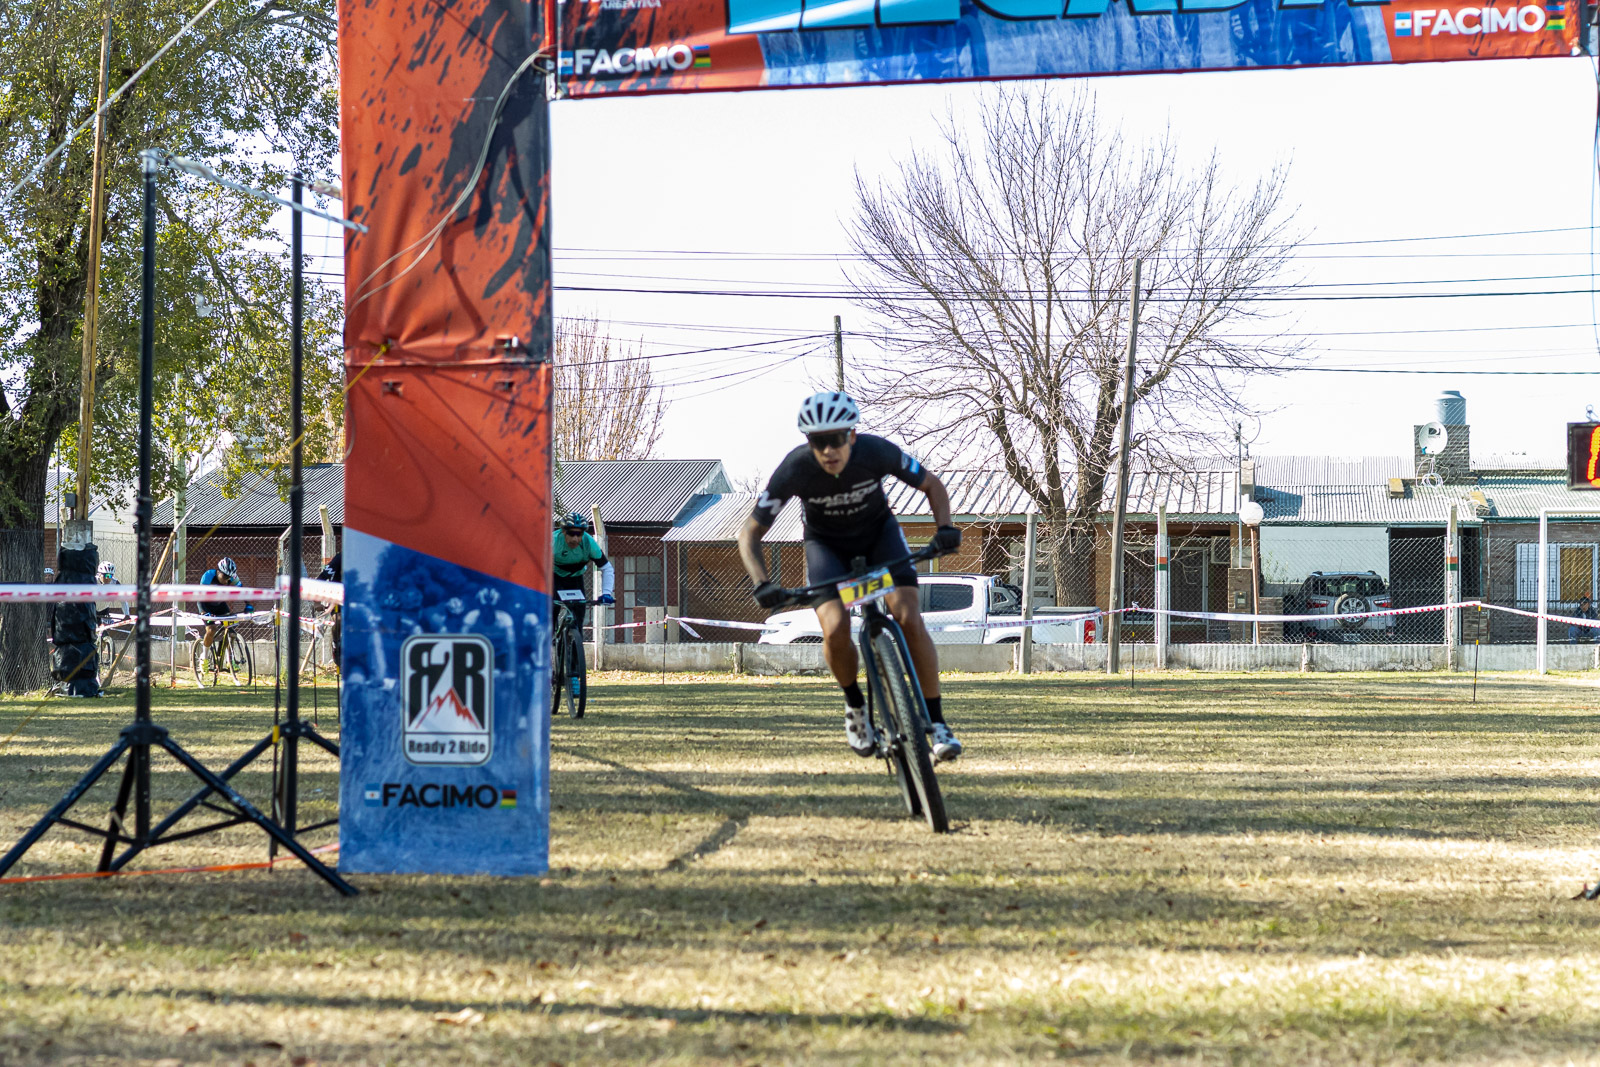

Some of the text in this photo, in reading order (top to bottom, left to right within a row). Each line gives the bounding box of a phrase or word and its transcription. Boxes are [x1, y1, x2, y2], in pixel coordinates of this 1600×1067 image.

[599, 0, 662, 9] ARGENTINA
[1413, 4, 1546, 37] FACIMO
[574, 44, 693, 76] FACIMO
[408, 739, 486, 755] Ready 2 Ride
[382, 783, 498, 809] FACIMO
